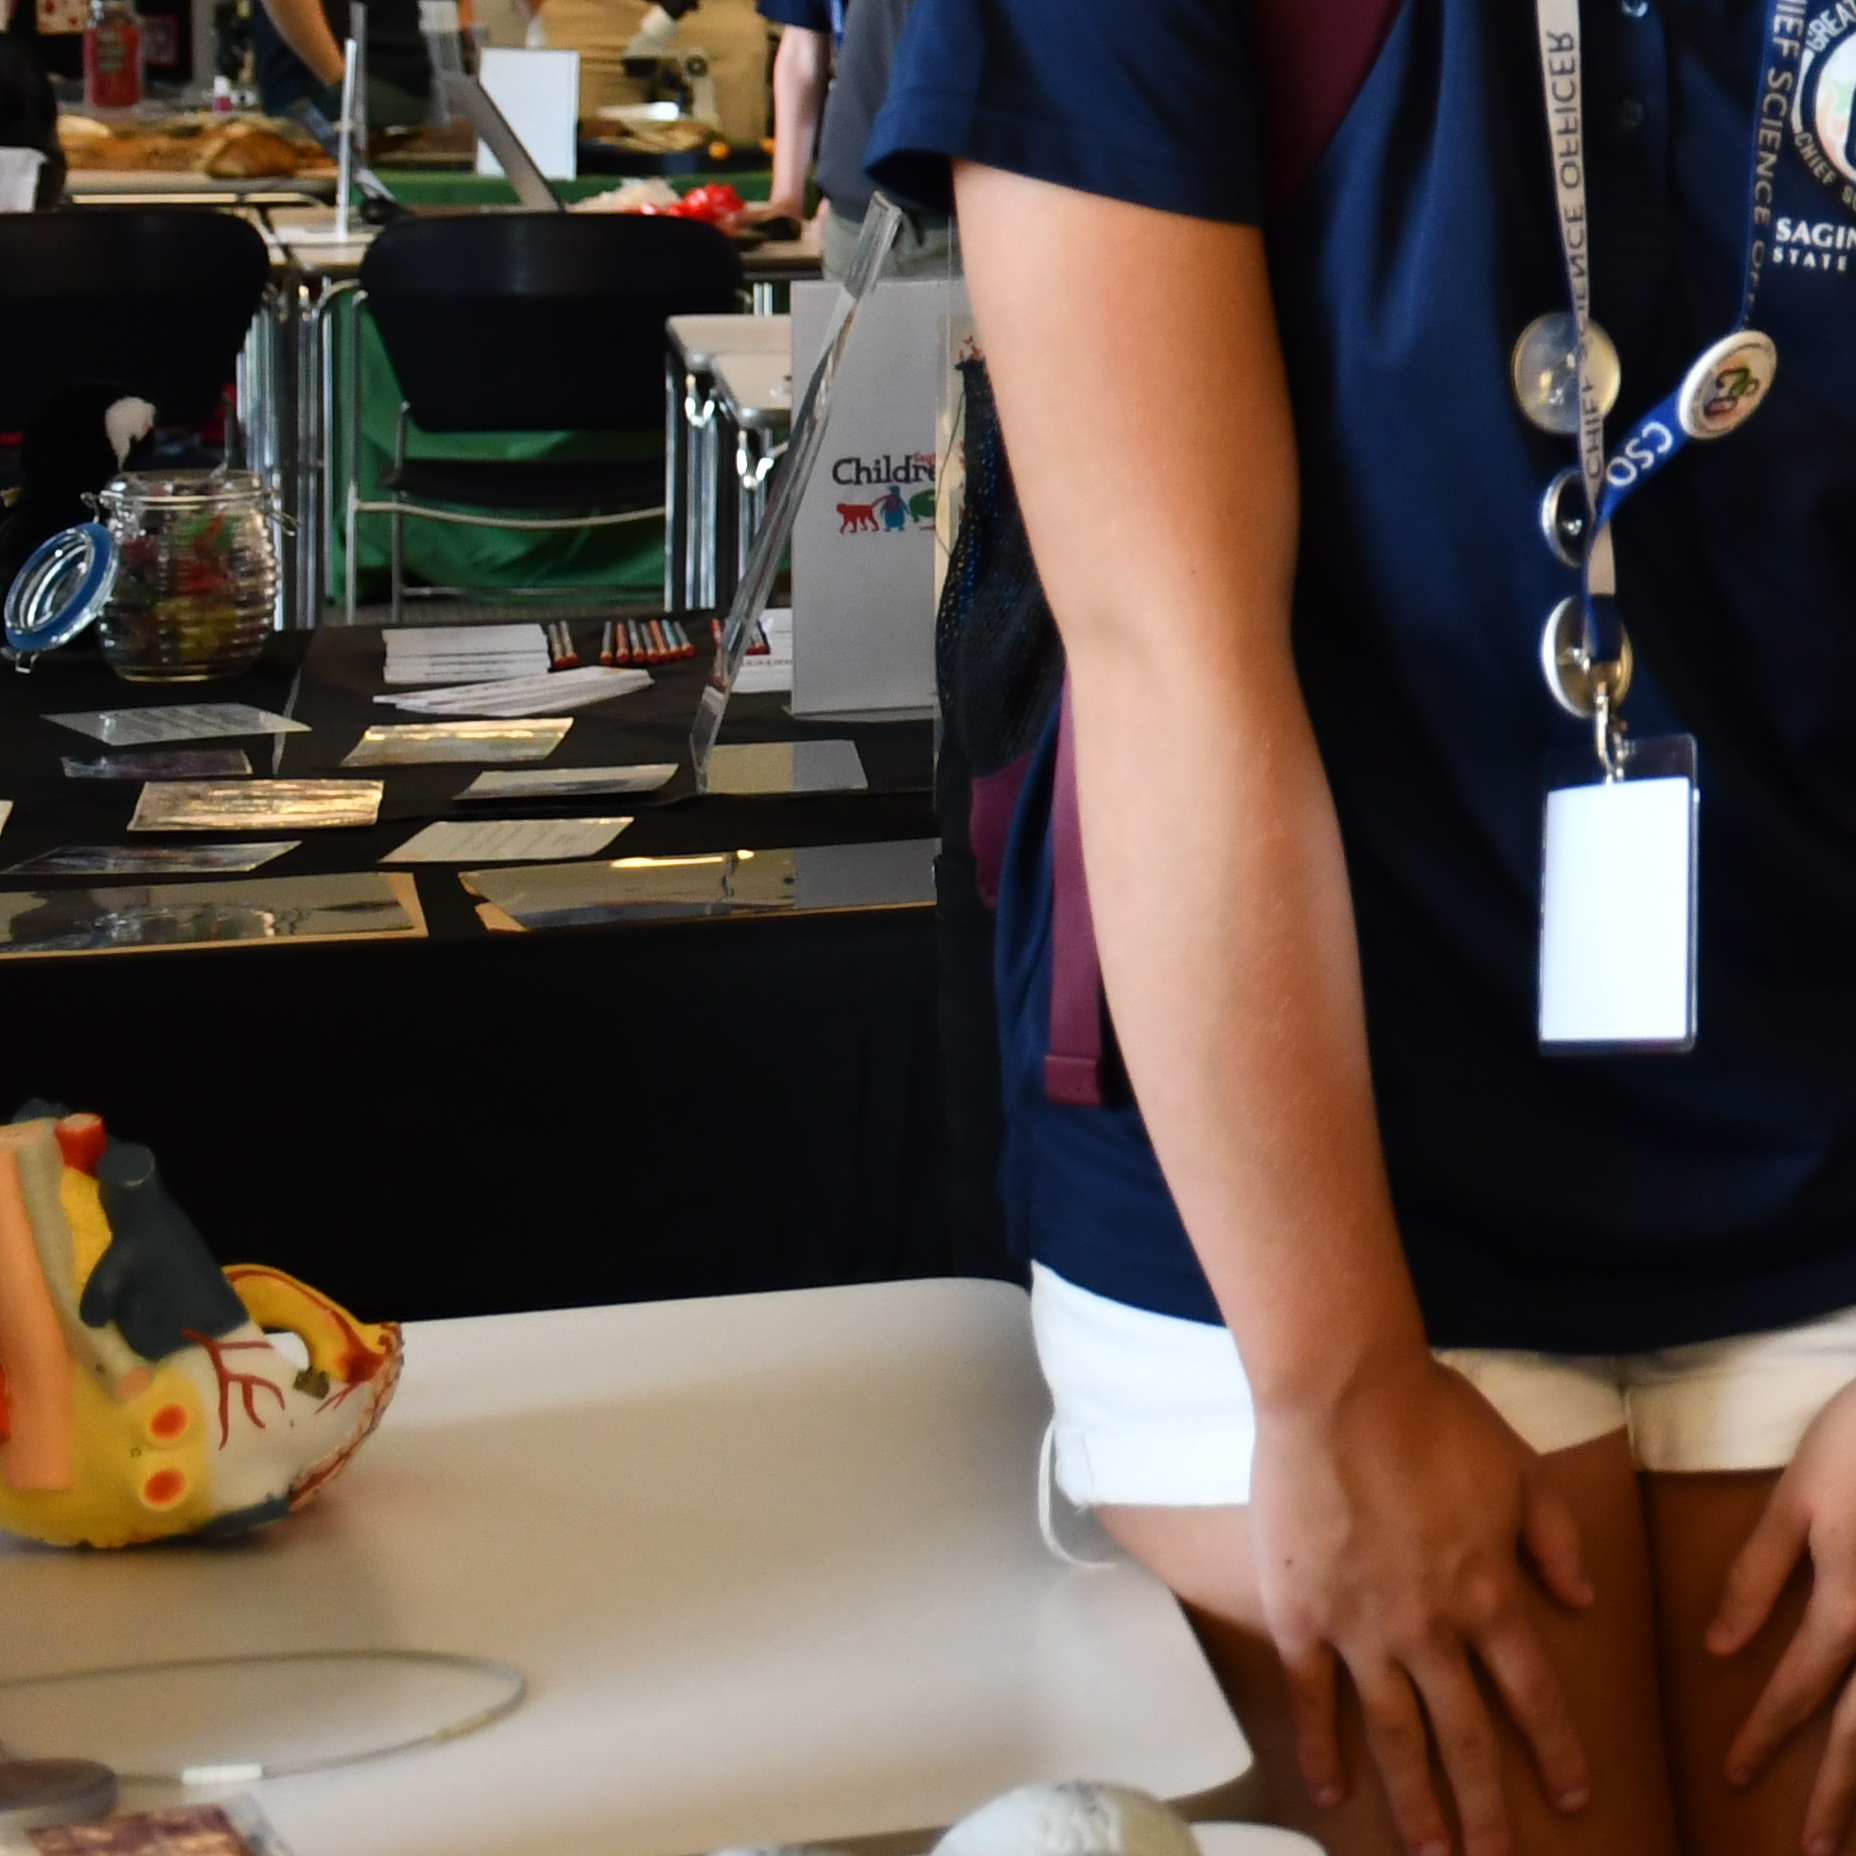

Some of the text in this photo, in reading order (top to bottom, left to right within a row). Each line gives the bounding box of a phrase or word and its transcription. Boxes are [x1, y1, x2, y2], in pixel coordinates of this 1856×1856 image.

[1753, 66, 1794, 226] SCIENCE
[1793, 130, 1838, 186] CHIEF
[1771, 246, 1848, 274] STATE
[1605, 421, 1673, 488] CSO
